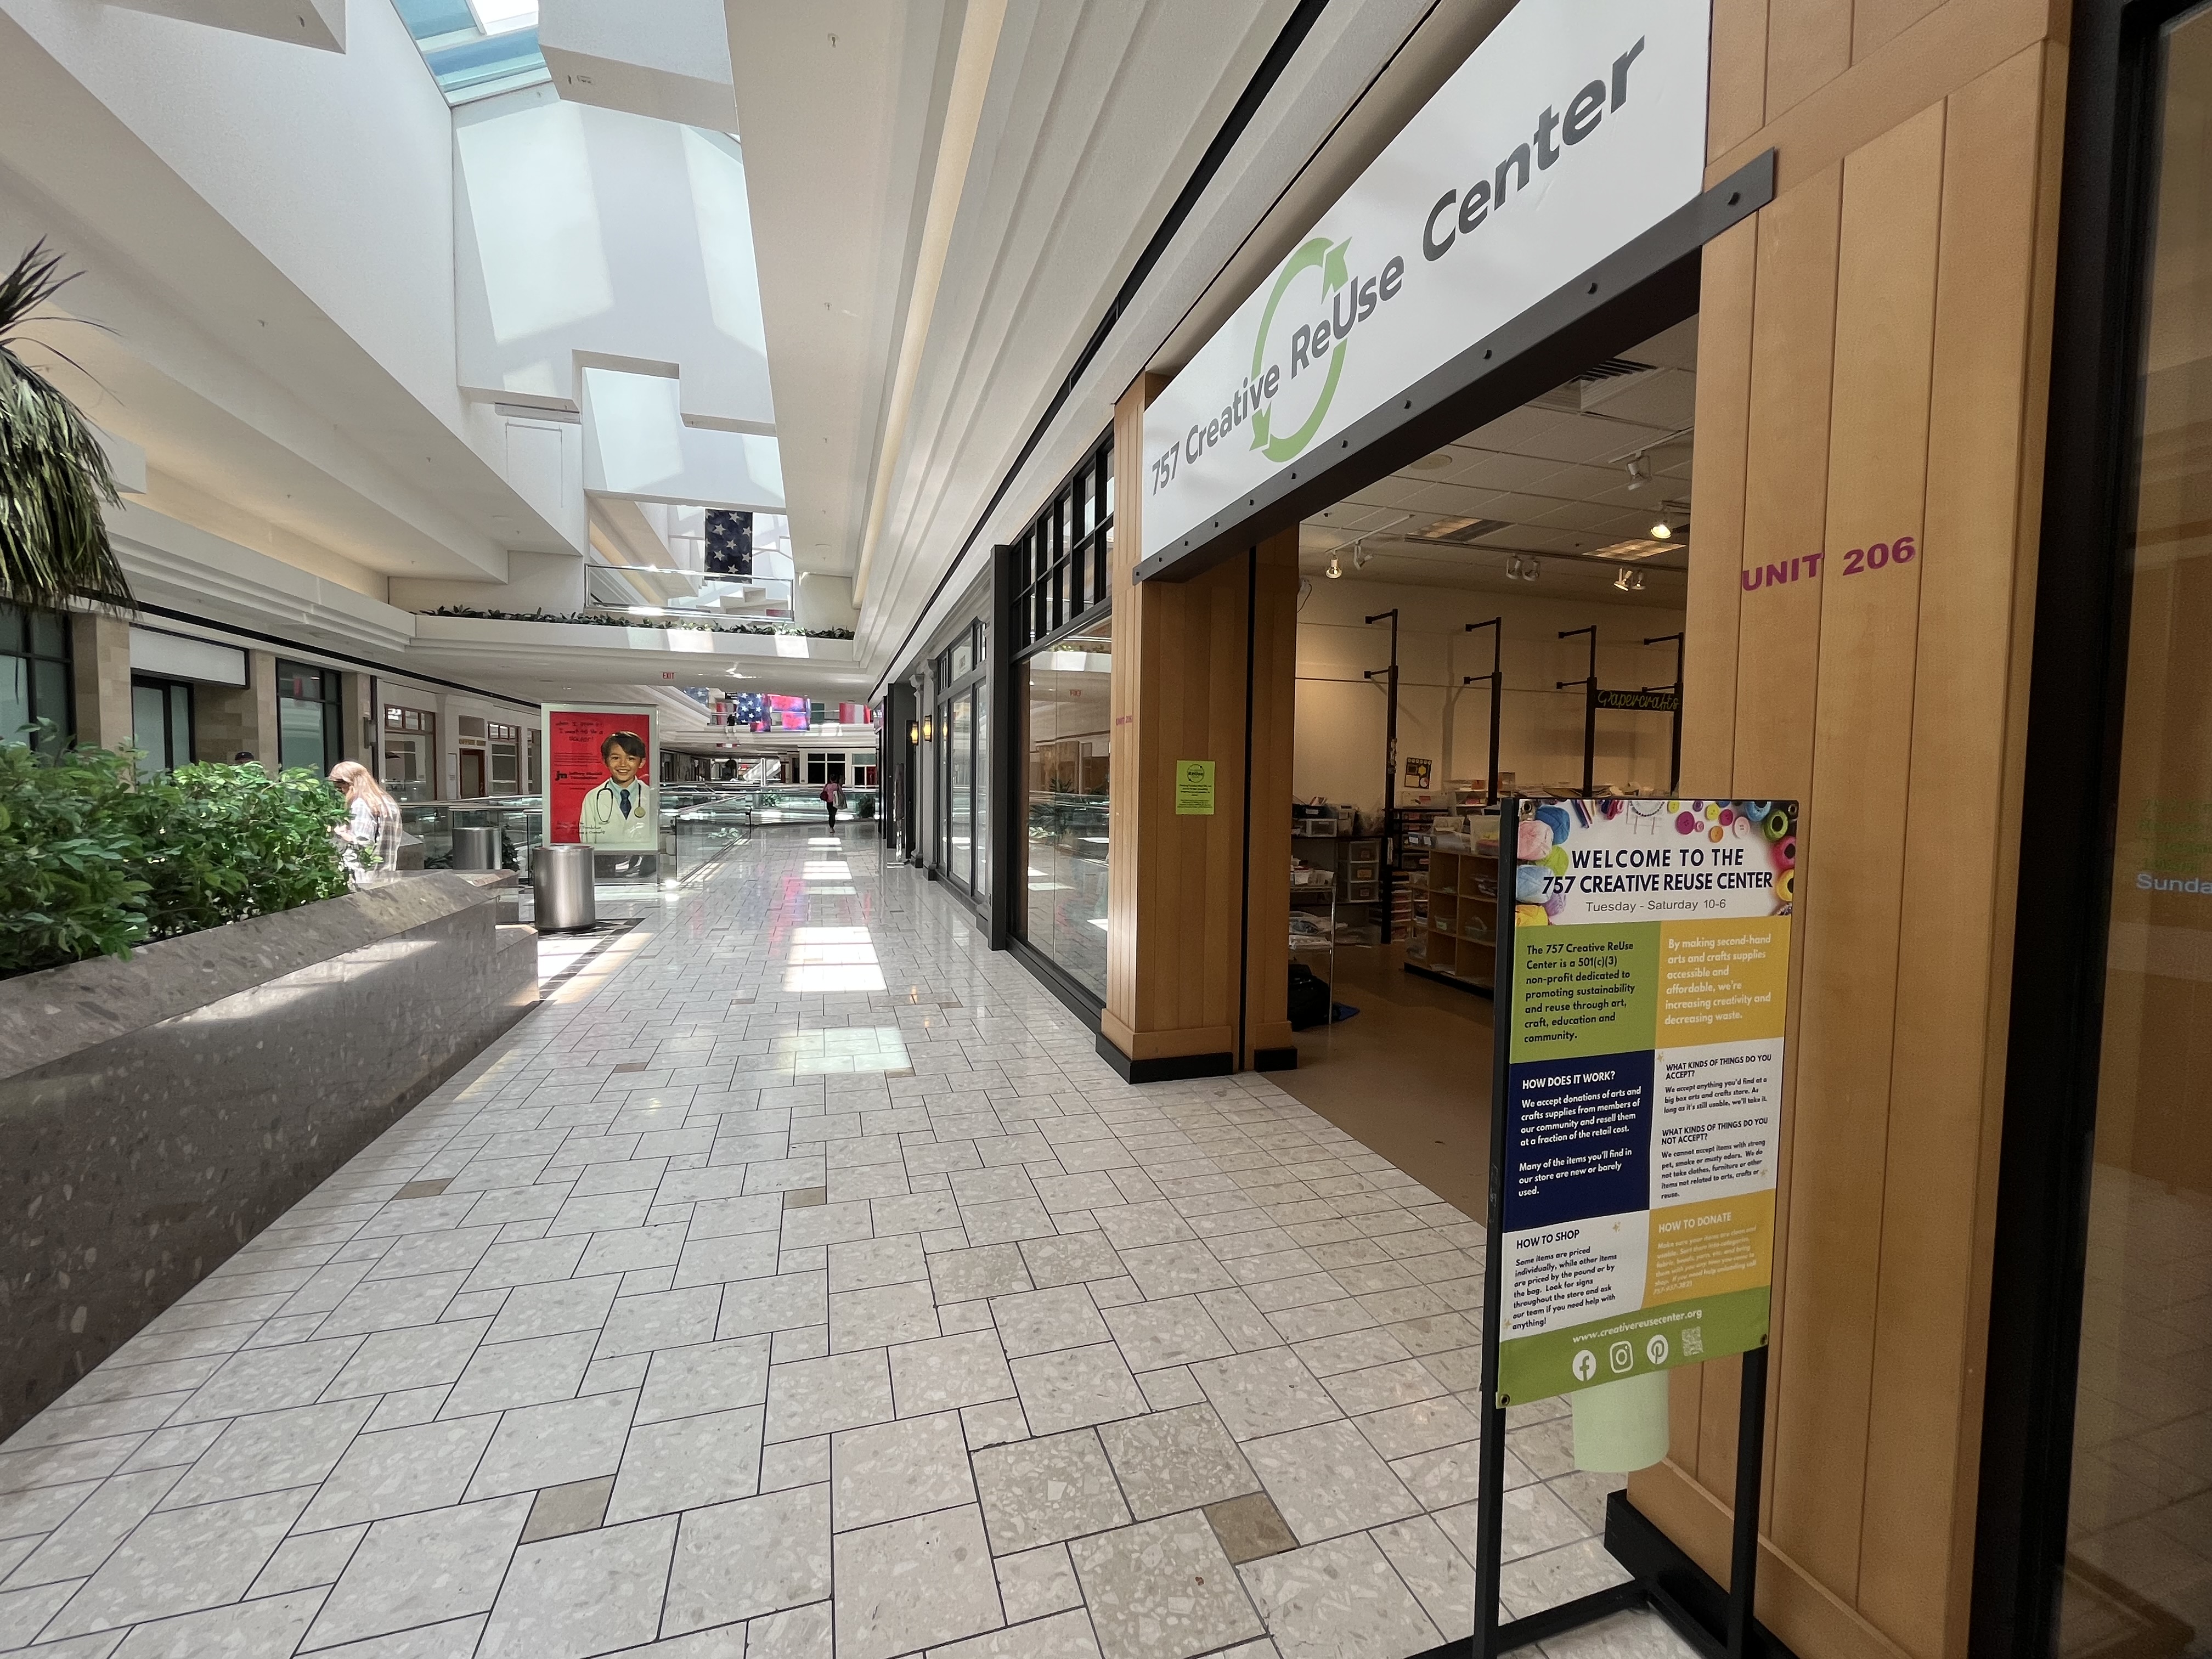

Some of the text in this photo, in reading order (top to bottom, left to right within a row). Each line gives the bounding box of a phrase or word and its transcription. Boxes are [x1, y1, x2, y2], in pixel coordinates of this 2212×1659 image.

[1152, 35, 1645, 496] 757 Creative ReUse Center
[1742, 537, 1916, 591] UNIT 206
[1598, 691, 1679, 710] Papercrafts
[1572, 848, 1745, 869] WELCOME TO THE
[1542, 872, 1773, 894] 757 CREATIVE REUSE CENTER
[1585, 900, 1637, 913] Tuesday
[1647, 899, 1699, 911] Saturday
[1703, 898, 1726, 909] 10-6
[1527, 941, 1633, 954] The 757 Creative ReUse
[1668, 934, 1771, 951] By making second-hand
[1527, 960, 1557, 969] Center
[1560, 959, 1566, 967] is
[1578, 956, 1617, 968] 501(c)(3)
[1668, 949, 1765, 964] arts and crafts supplies
[1526, 972, 1573, 985] non-profit
[1576, 969, 1619, 981] dedicated
[1667, 965, 1729, 979] accessible and
[1526, 984, 1635, 1001] promoting sustainability
[1666, 980, 1742, 994] affordable, we're
[1525, 1003, 1542, 1013] and
[1573, 998, 1609, 1011] through
[1611, 999, 1627, 1007] art,
[1666, 992, 1771, 1009] increasing creativity and
[1525, 1012, 1615, 1028] craft, education and
[1665, 1012, 1742, 1024] decreasing waste.
[1525, 1031, 1577, 1042] community.
[1666, 1063, 1686, 1071] WHAT
[1688, 1060, 1708, 1069] KINDS
[1720, 1057, 1743, 1065] THINGS
[1522, 1071, 1615, 1089] HOW DOES IT WORK?
[1666, 1071, 1695, 1080] ACCEPT?
[1522, 1086, 1641, 1108] We accept donations of arts and
[1521, 1098, 1640, 1121] crafts supplies from members of
[1536, 1120, 1578, 1132] community
[1580, 1116, 1595, 1126] and
[1596, 1113, 1616, 1124] resell
[1618, 1113, 1635, 1121] them
[1662, 1128, 1682, 1136] WHAT
[1684, 1125, 1705, 1134] KINDS
[1718, 1121, 1741, 1130] THINGS
[1538, 1133, 1567, 1144] fraction
[1569, 1131, 1577, 1139] of
[1578, 1130, 1590, 1138] the
[1592, 1126, 1611, 1137] retail
[1678, 1133, 1707, 1143] ACCEPT?
[1519, 1163, 1541, 1171] Many
[1543, 1159, 1551, 1168] of
[1553, 1158, 1564, 1166] the
[1588, 1151, 1608, 1164] you'll
[1610, 1149, 1623, 1158] find
[1598, 1161, 1622, 1171] barely
[1519, 1186, 1539, 1196] used.
[1659, 1212, 1731, 1233] HOW TO DONATE
[1517, 1229, 1579, 1249] HOW TO SHOP
[1569, 1246, 1590, 1257] priced
[1515, 1263, 1557, 1277] individually,
[1559, 1260, 1577, 1268] while
[1528, 1274, 1549, 1286] priced
[1551, 1273, 1559, 1282] by
[1574, 1267, 1595, 1278] pound
[1606, 1264, 1615, 1272] by
[1546, 1283, 1562, 1291] Look
[1576, 1279, 1593, 1287] signs
[1514, 1295, 1552, 1308] throughout
[1586, 1286, 1599, 1295] and
[1513, 1317, 1547, 1330] anything!
[1573, 1310, 1702, 1343] www.creativereusecenter.org
